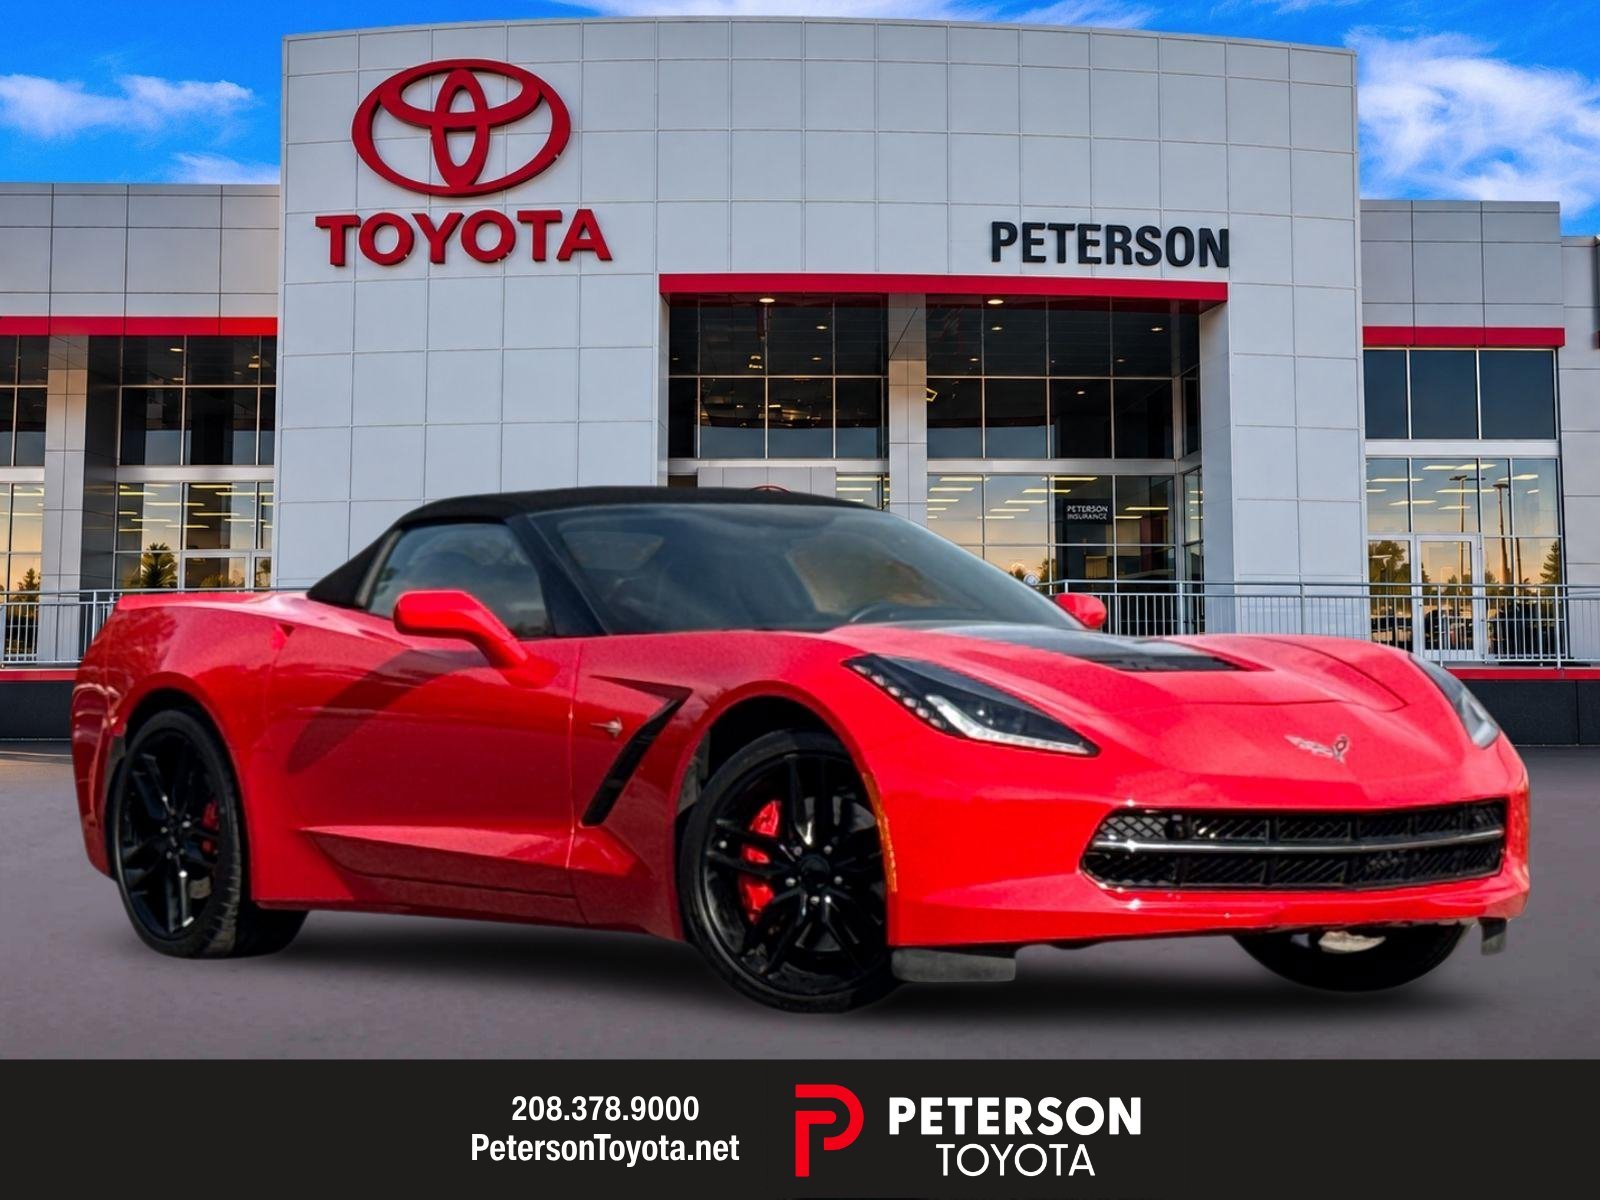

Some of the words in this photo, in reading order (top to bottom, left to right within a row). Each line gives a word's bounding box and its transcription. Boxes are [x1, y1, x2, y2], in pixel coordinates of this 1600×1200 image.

[316, 209, 611, 266] TOYOTA
[991, 221, 1230, 269] PETERSON
[1066, 505, 1109, 513] PETERSON
[1066, 513, 1108, 521] INSURANCE
